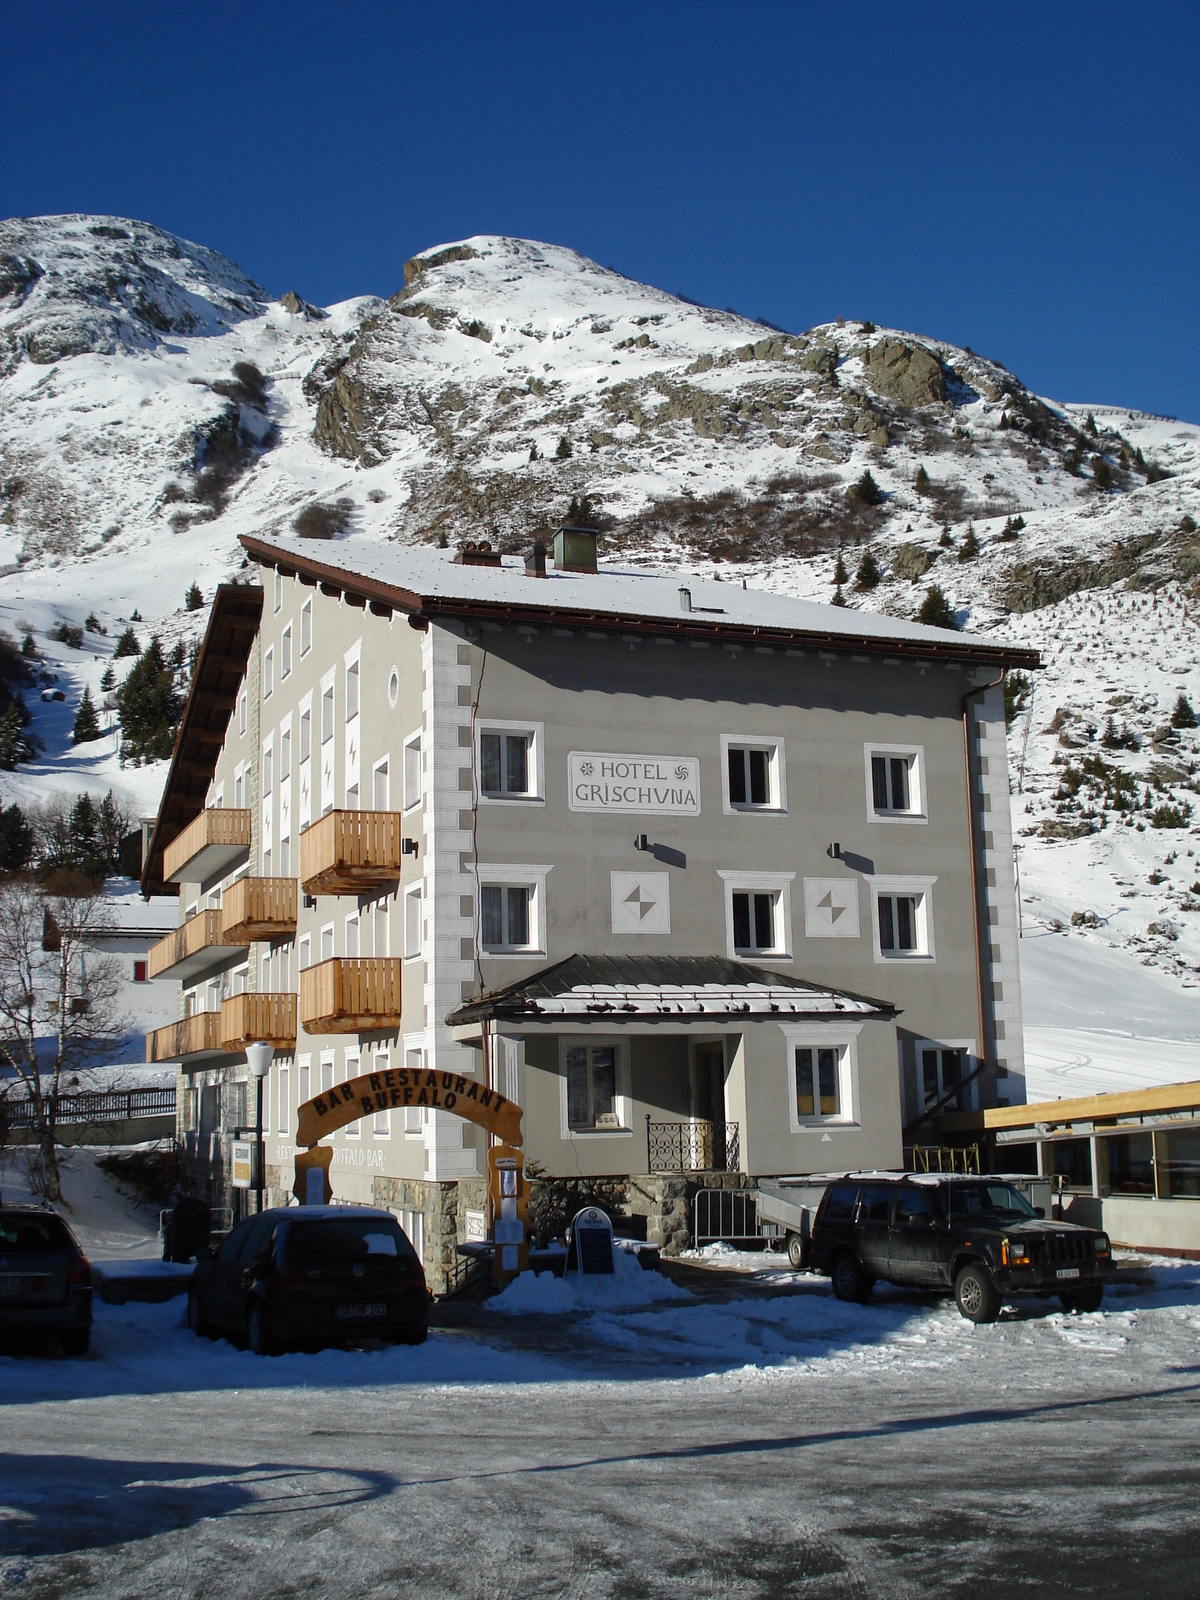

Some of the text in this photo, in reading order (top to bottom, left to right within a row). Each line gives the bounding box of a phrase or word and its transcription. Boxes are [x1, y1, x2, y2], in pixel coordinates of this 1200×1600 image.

[601, 762, 667, 780] HOTEL
[312, 1069, 507, 1117] BAR RESTAURANT
[360, 1089, 457, 1115] BUFFALO
[370, 1303, 385, 1314] 101
